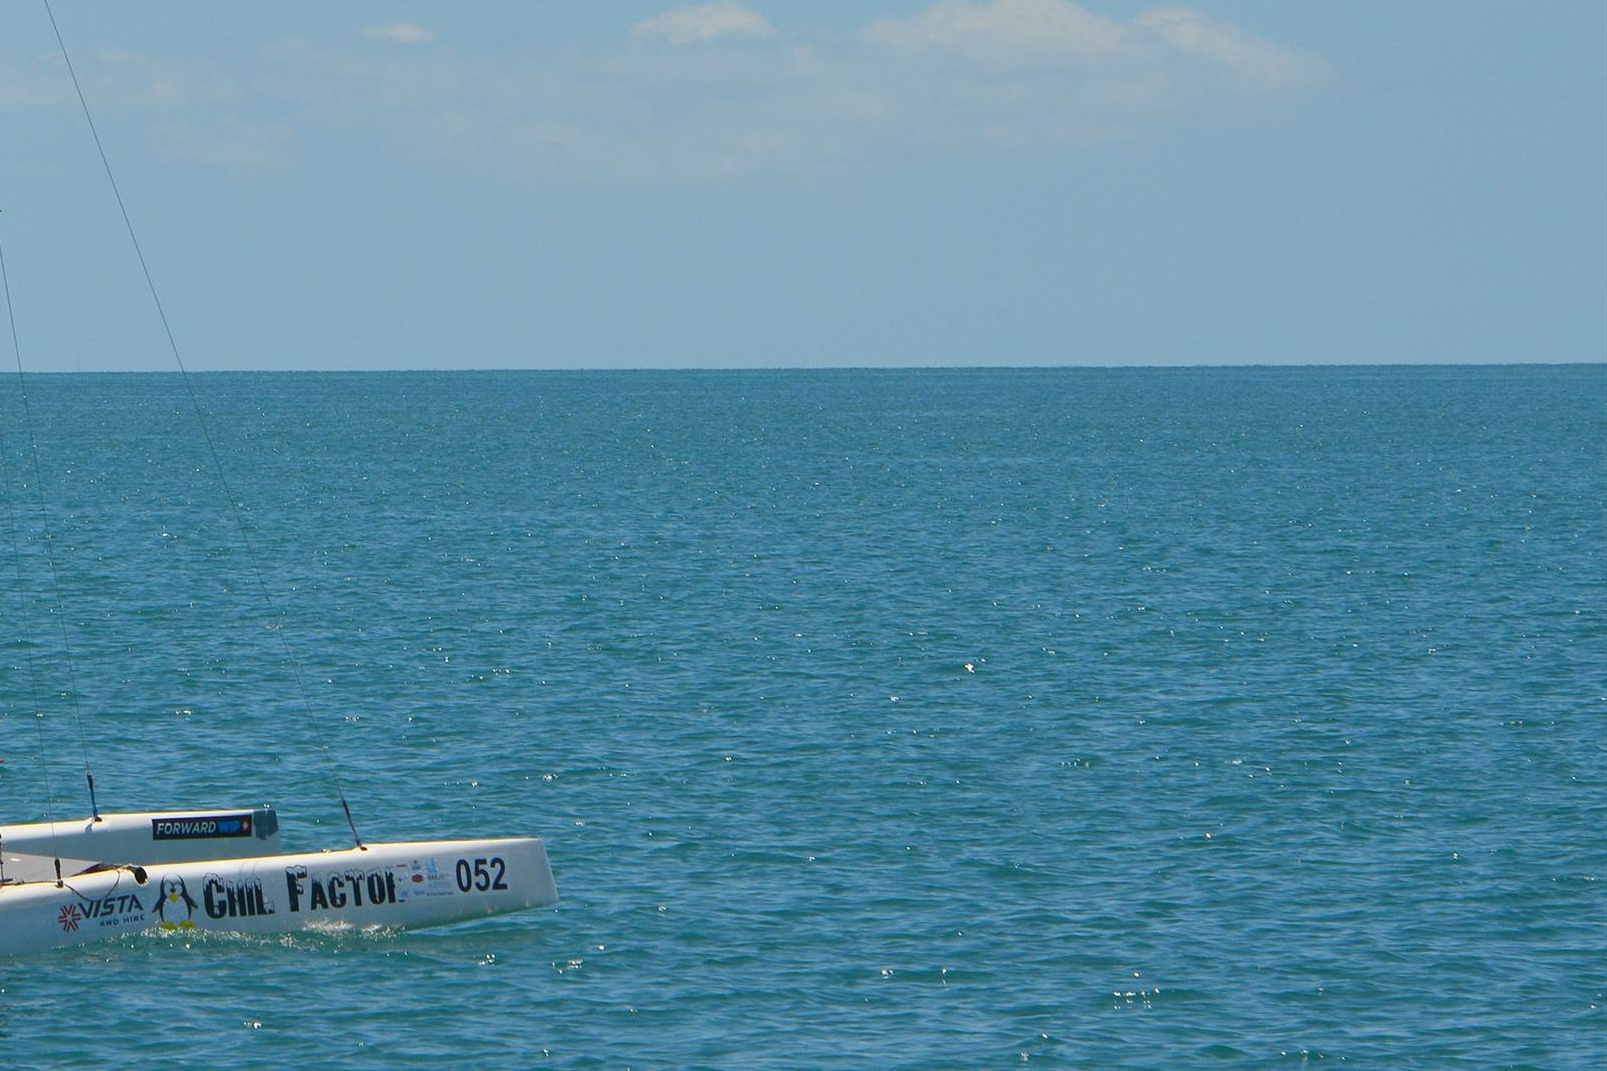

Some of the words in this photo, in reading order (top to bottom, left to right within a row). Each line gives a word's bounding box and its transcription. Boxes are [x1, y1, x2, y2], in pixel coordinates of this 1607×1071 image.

[156, 821, 216, 835] FORWARD
[456, 857, 508, 892] 052
[78, 894, 144, 919] VISTA
[99, 917, 120, 927] 4WD
[123, 913, 145, 924] HIRE
